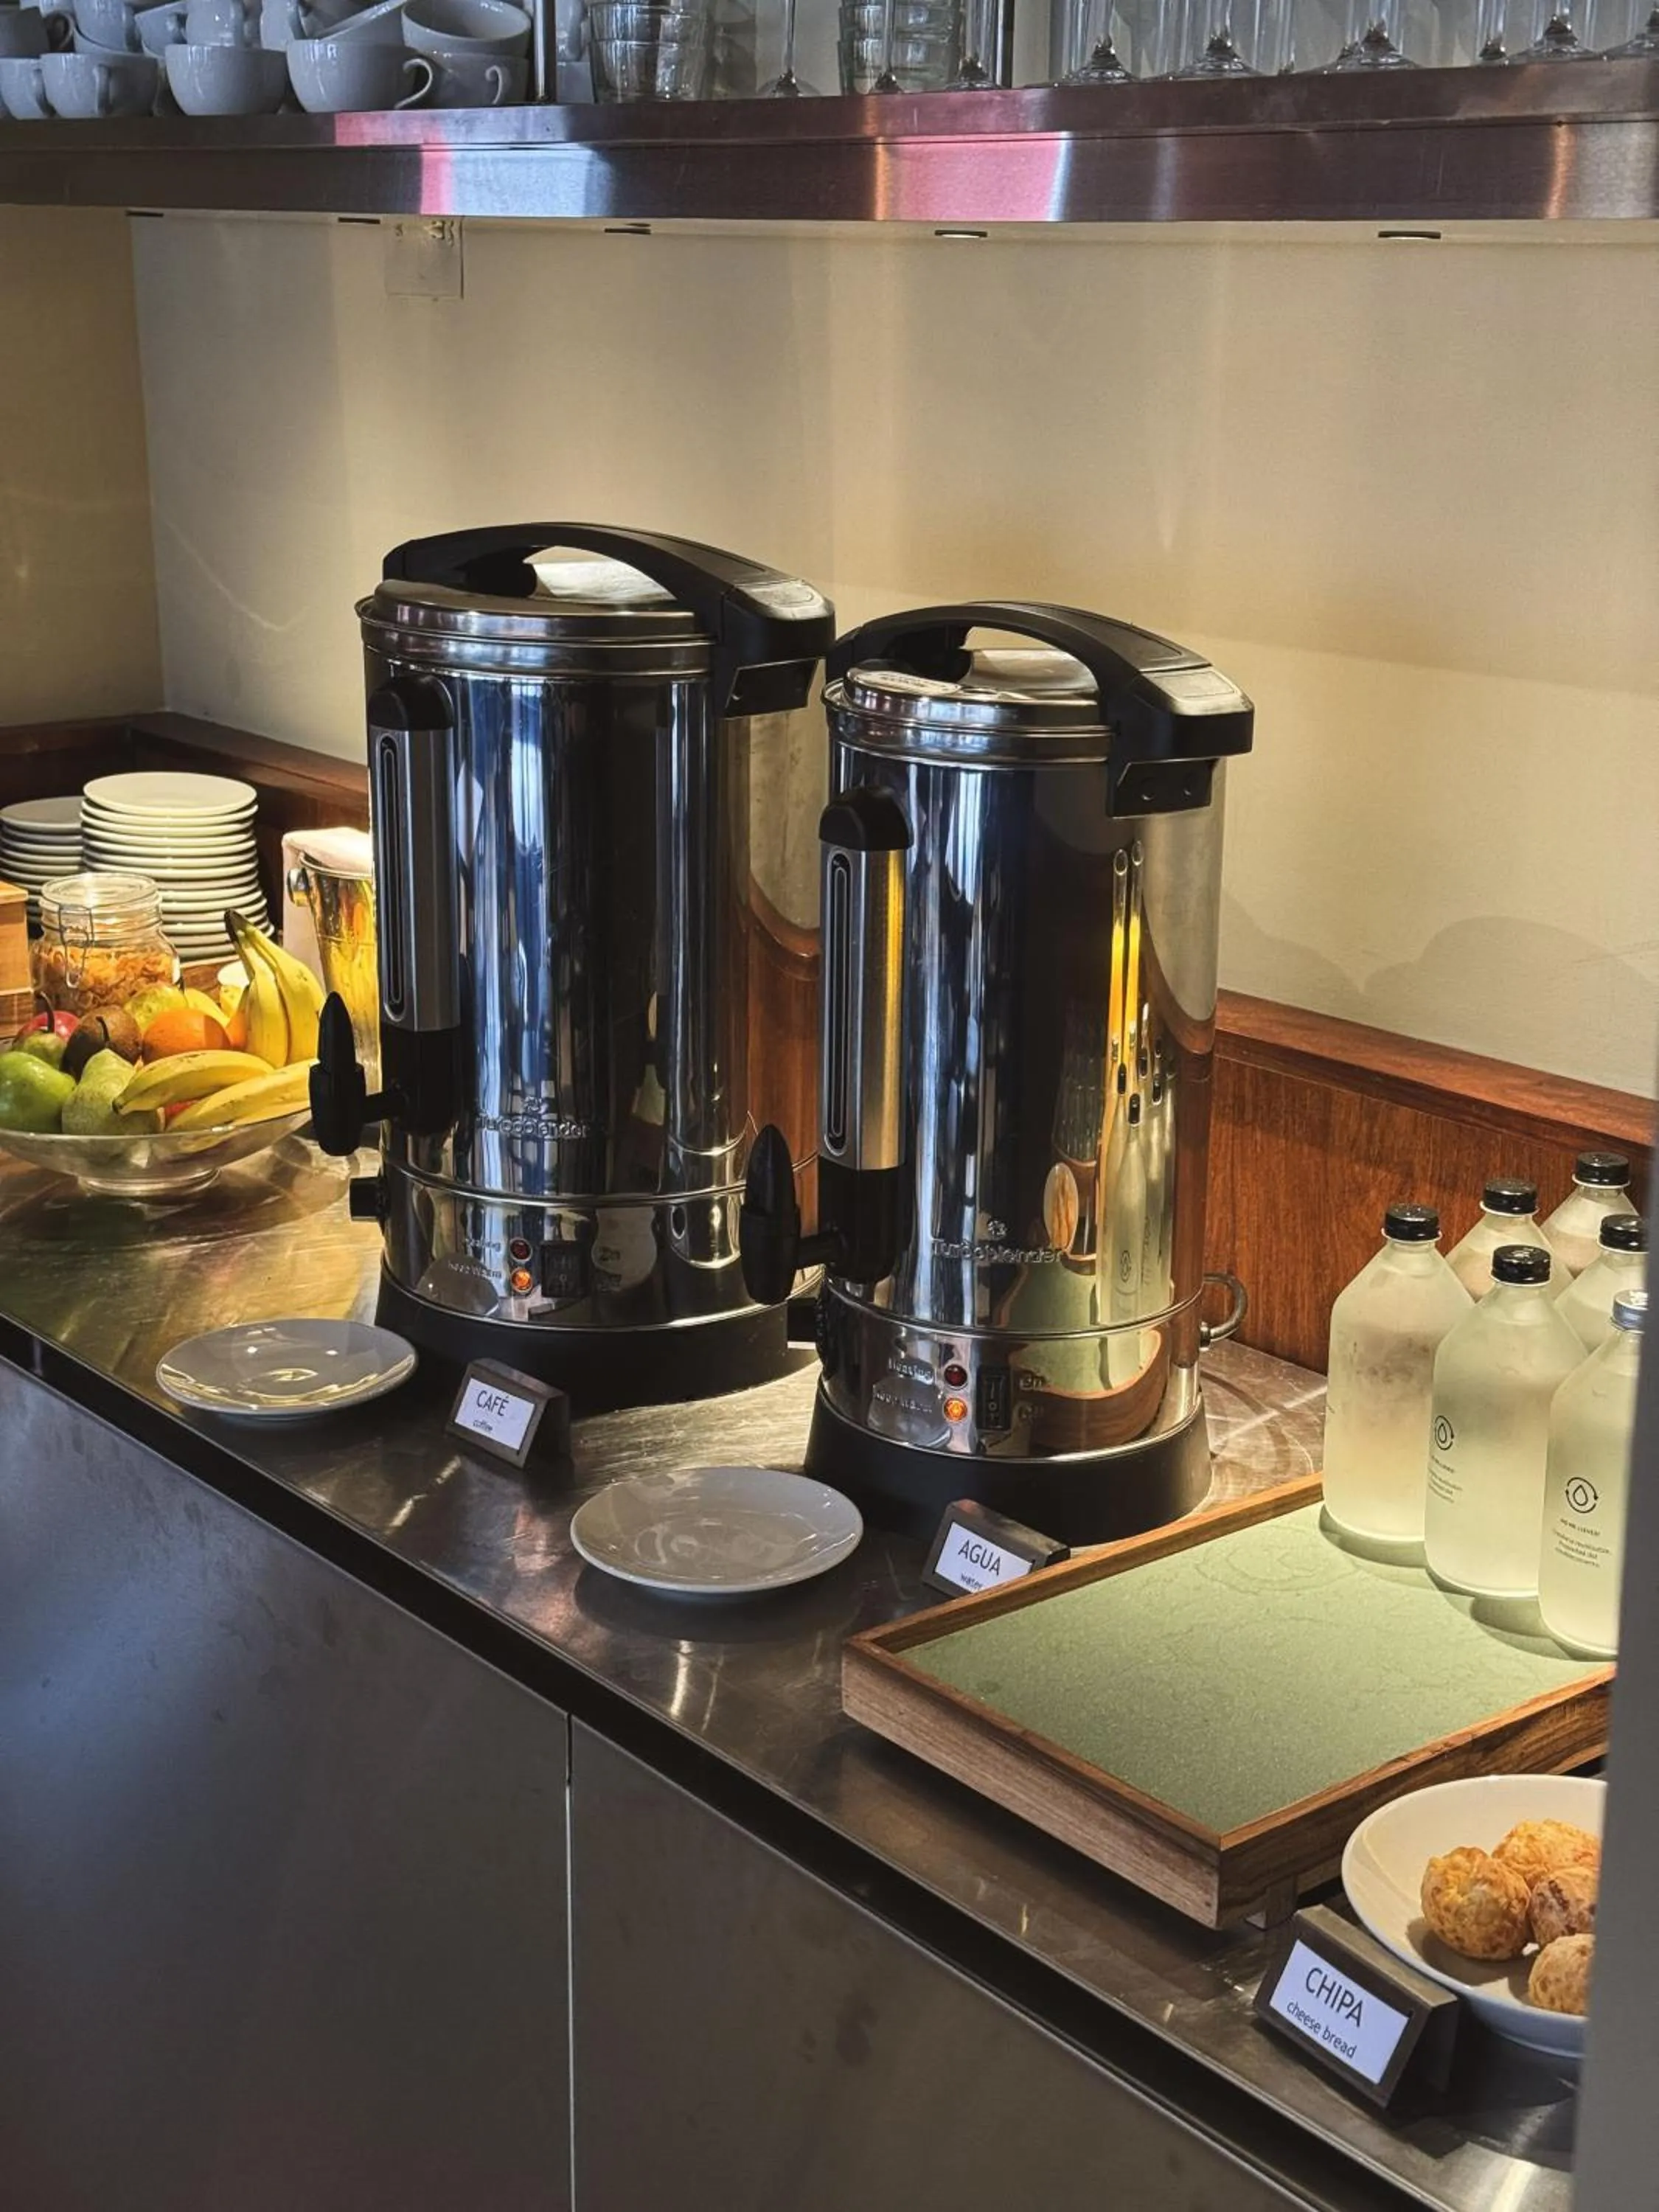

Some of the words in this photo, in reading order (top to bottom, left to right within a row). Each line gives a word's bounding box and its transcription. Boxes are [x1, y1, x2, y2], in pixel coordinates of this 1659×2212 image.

[931, 1237, 1063, 1263] Turboblender
[476, 1390, 509, 1416] CAFÉ
[473, 1419, 493, 1433] coffee
[958, 1540, 1002, 1576] AGUA
[961, 1573, 984, 1590] water
[1305, 1967, 1364, 2028] CHIPA
[1286, 1999, 1321, 2034] cheese
[1322, 2026, 1357, 2059] bread
